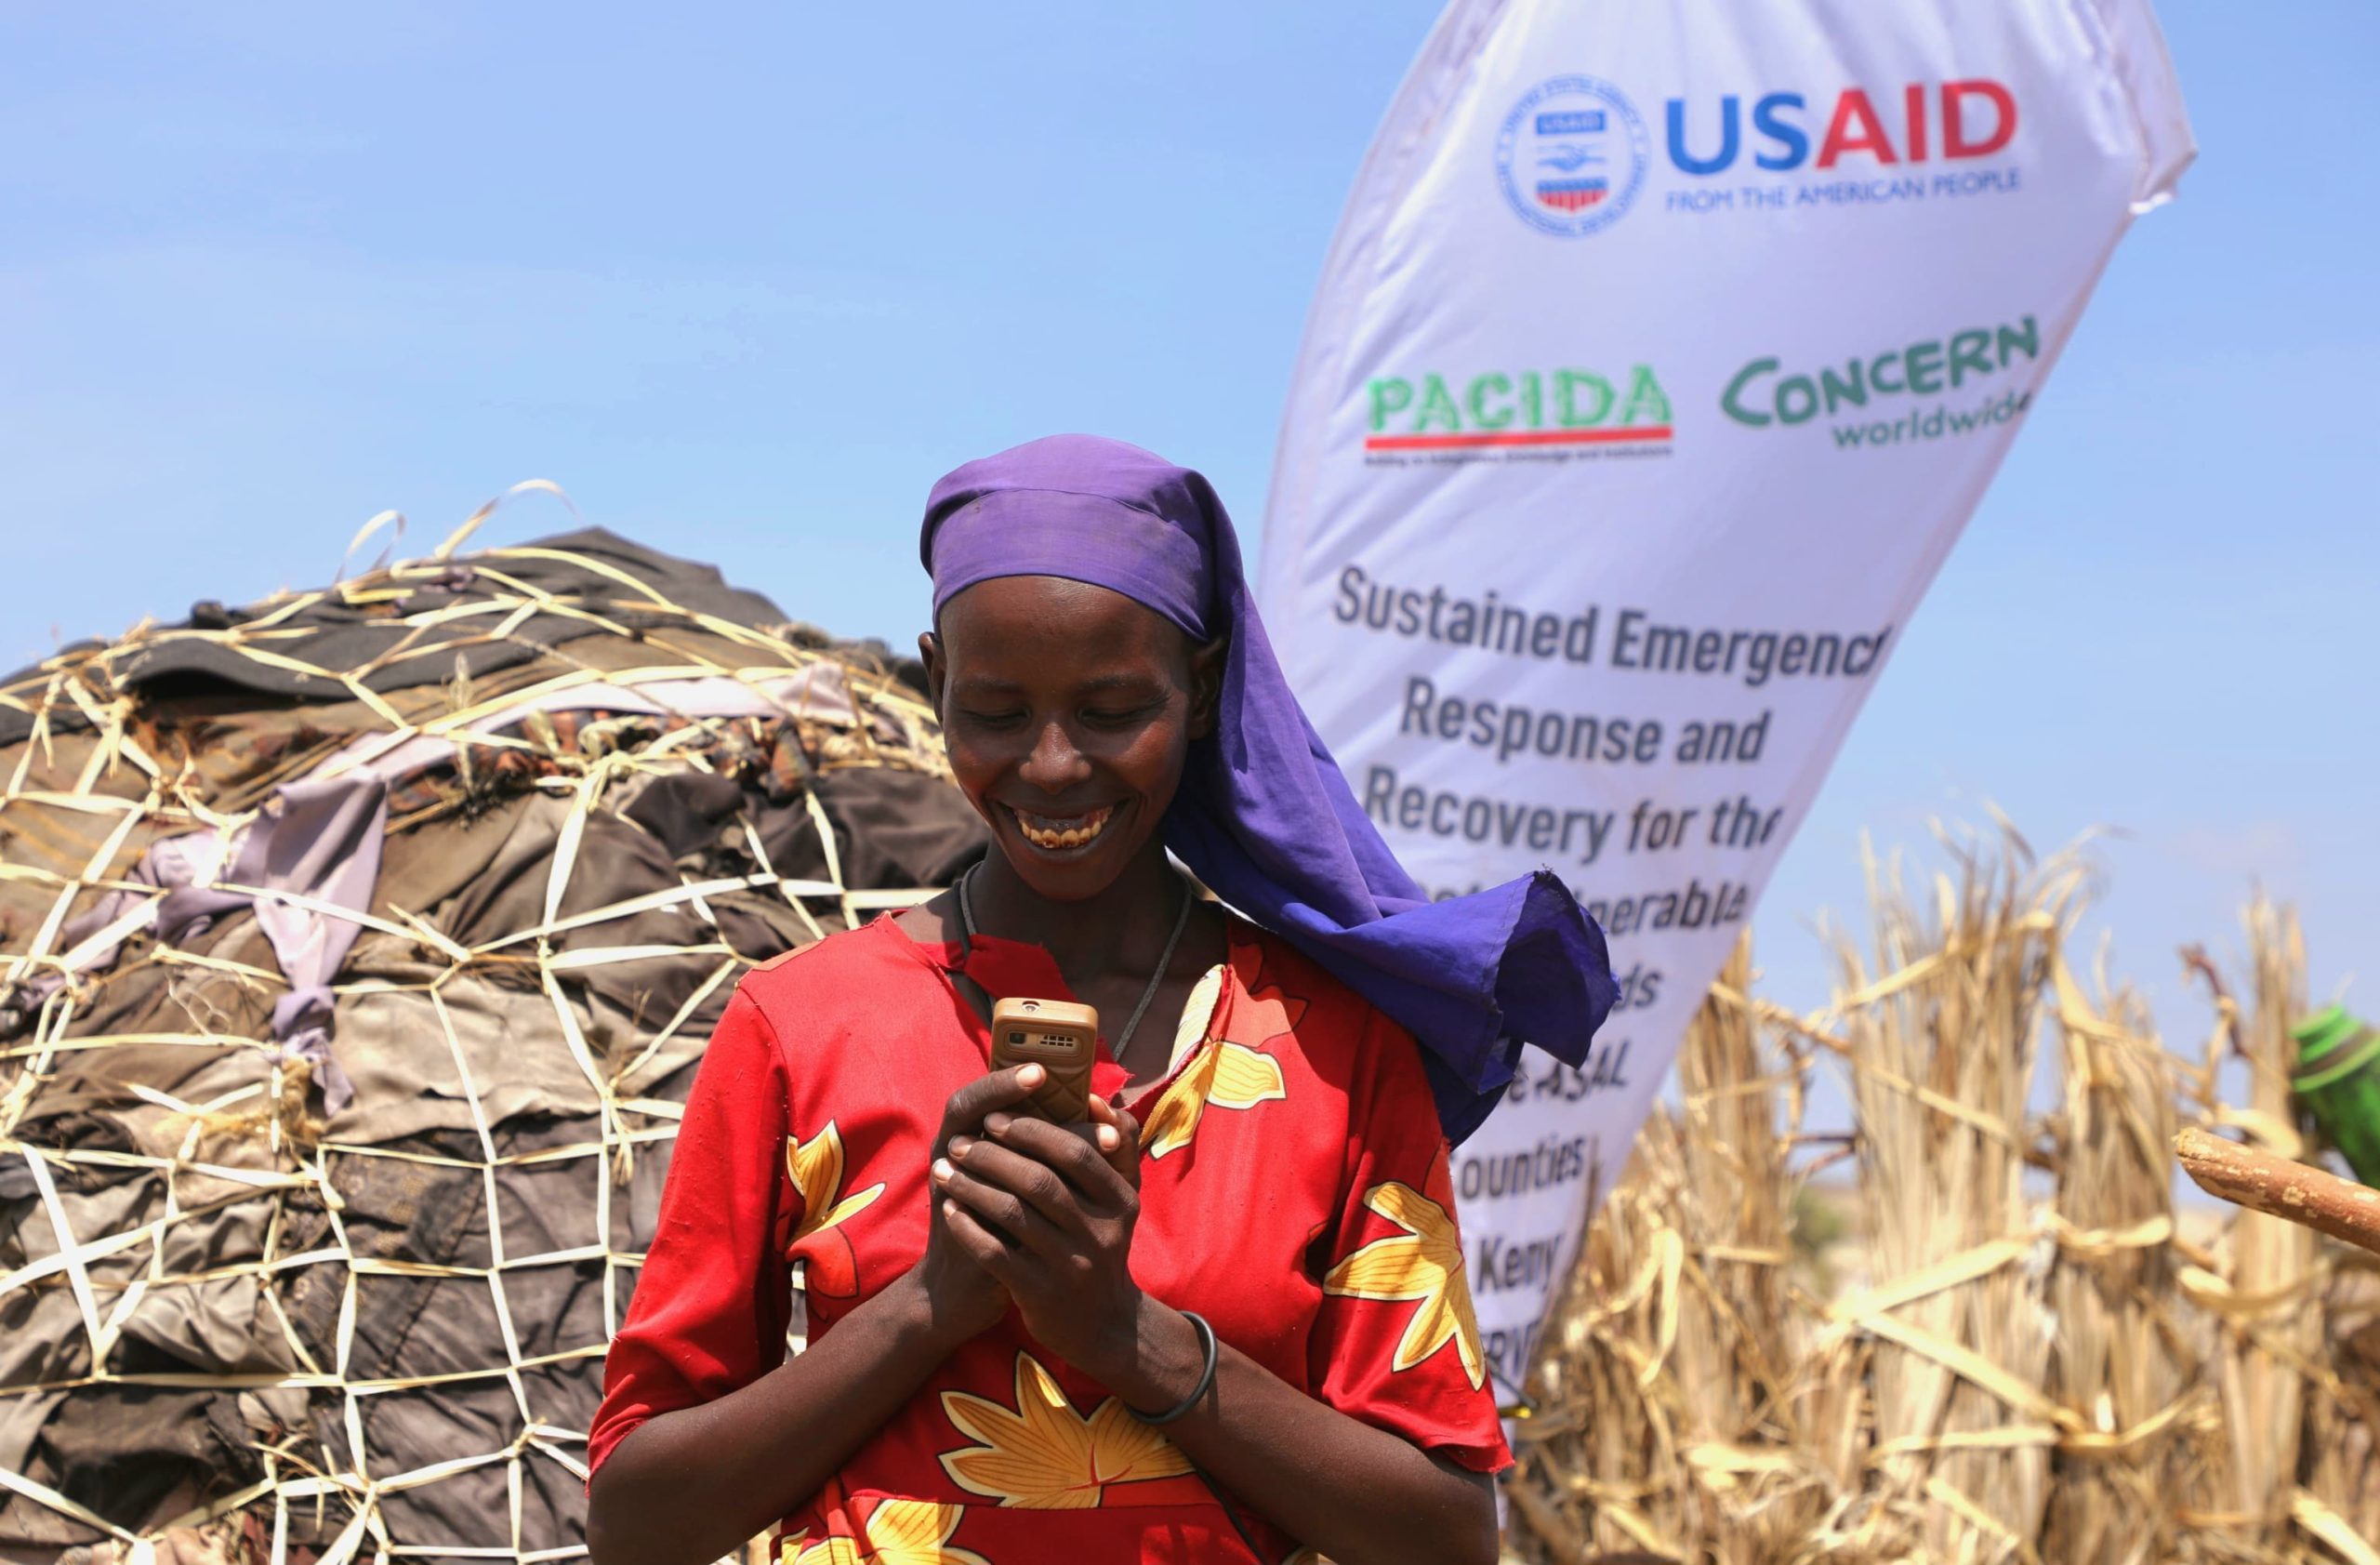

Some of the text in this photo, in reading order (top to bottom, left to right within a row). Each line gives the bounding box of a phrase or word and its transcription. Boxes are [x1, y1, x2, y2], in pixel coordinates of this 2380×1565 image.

[1665, 79, 2018, 176] USAID
[1667, 168, 2021, 212] FROM THE AMERICAN PEOPLE
[1366, 365, 1673, 433] PACIDA
[1334, 565, 1600, 665] Sustained
[1400, 676, 1772, 764] Response and
[1364, 765, 1614, 868] Recovery
[1628, 798, 1699, 853] for
[1574, 877, 1749, 935] nerable
[1451, 1133, 1585, 1200] ounties
[1476, 1232, 1564, 1294] Keny
